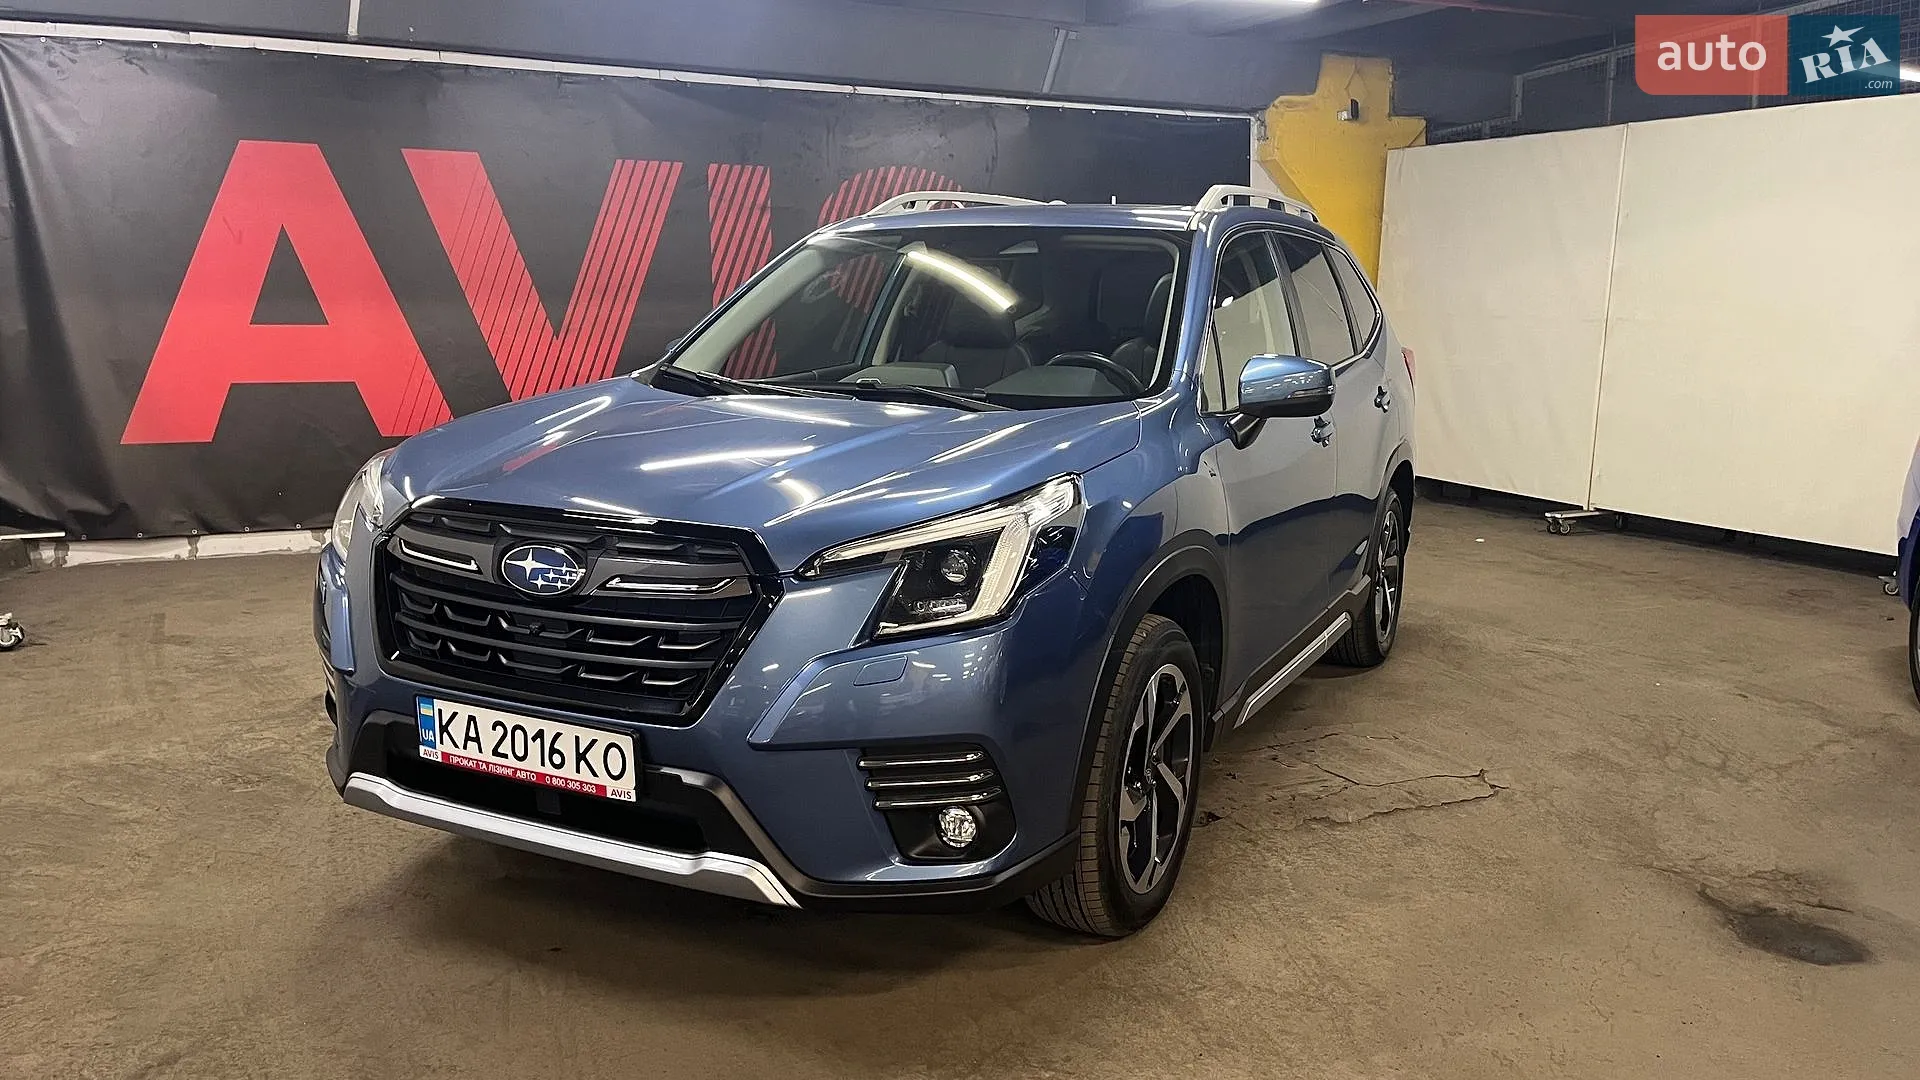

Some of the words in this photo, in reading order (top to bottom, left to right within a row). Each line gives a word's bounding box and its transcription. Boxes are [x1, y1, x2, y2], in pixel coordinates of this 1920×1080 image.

[421, 728, 435, 743] UA
[437, 708, 484, 754] KA
[491, 720, 566, 770] 2016
[574, 734, 627, 781] KO
[422, 748, 439, 760] AVIS
[449, 755, 478, 768] ПРОКАТ
[478, 761, 488, 771] ТА
[488, 763, 515, 777] ЛІЗИНГ
[515, 769, 537, 781] АВТО
[545, 776, 551, 784] 0
[551, 777, 566, 787] 800
[566, 780, 581, 790] 305
[581, 783, 596, 793] 303
[610, 788, 632, 800] AVIS
